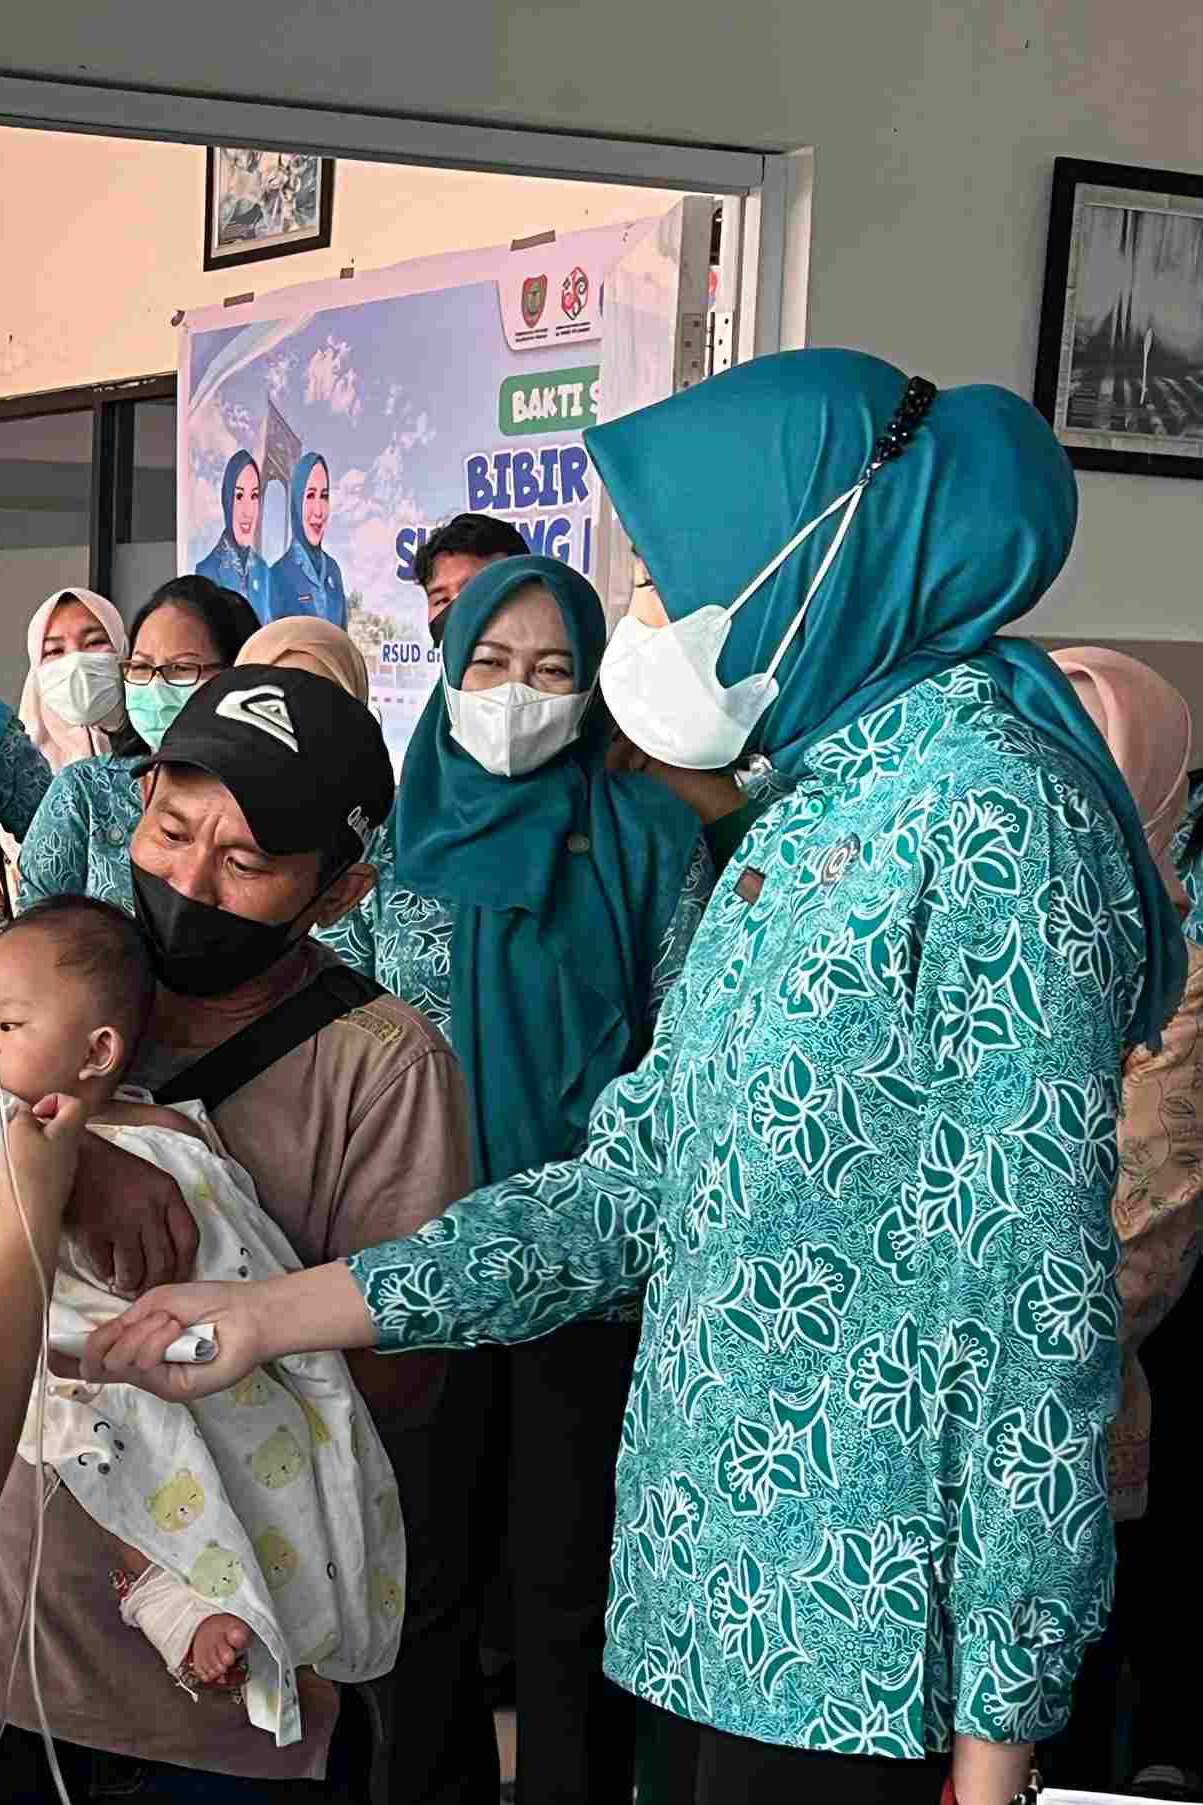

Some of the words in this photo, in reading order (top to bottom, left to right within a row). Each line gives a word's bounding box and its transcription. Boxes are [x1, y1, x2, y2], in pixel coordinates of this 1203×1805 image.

[512, 382, 583, 423] BAKTI
[466, 445, 589, 511] BIBIR
[382, 643, 421, 663] RSUD
